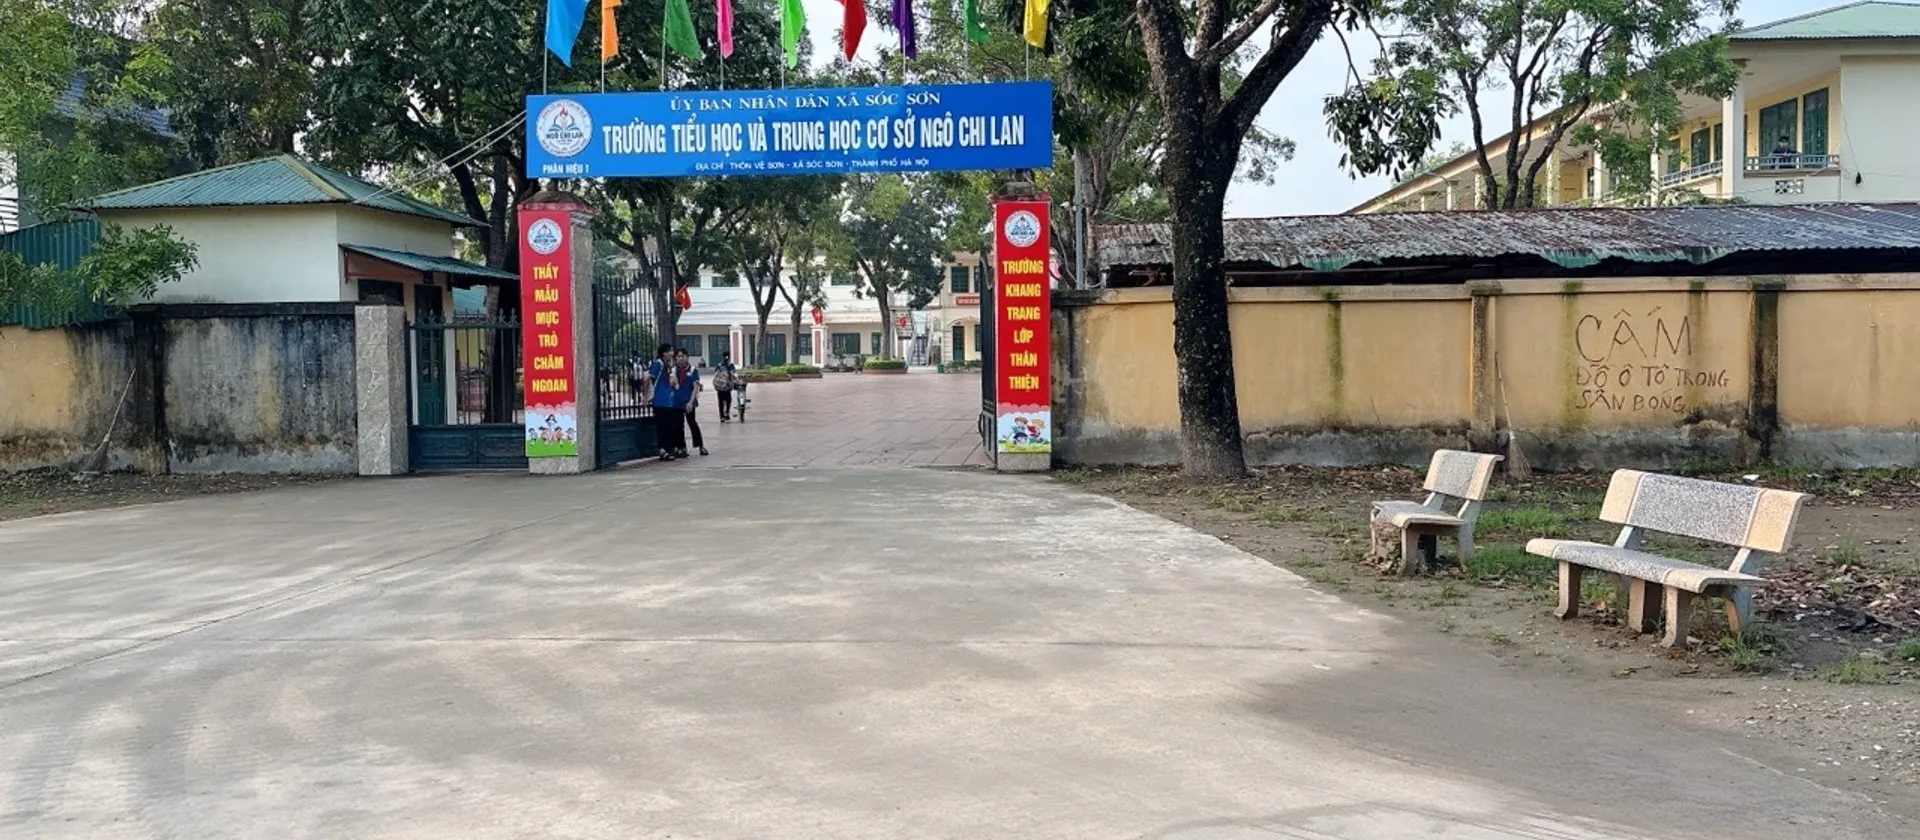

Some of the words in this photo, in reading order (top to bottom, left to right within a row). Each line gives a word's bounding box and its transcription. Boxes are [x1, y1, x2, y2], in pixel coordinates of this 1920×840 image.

[700, 99, 733, 110] BAN
[739, 94, 788, 110] NHÂN
[795, 92, 829, 108] DÂN
[836, 91, 859, 107] XÃ
[865, 90, 898, 106] SÓC
[906, 91, 940, 105] SƠN
[602, 117, 666, 154] TRƯỜNG
[671, 113, 705, 152] TIỂU
[711, 122, 743, 157] HỌC
[748, 116, 767, 152] VÀ
[772, 120, 825, 152] TRUNG
[829, 119, 861, 155] HỌC
[866, 116, 889, 150] CƠ
[893, 108, 916, 149] SỞ
[920, 111, 954, 148] NGÔ
[958, 116, 986, 147] CHI
[990, 114, 1025, 146] LAN
[542, 163, 564, 174] PHÂN
[565, 162, 583, 175] HIỆU
[585, 163, 590, 173] 1
[1002, 257, 1044, 274] TRƯỜNG
[1005, 283, 1041, 297] KHANG
[535, 310, 560, 328] MỰC
[1007, 306, 1041, 320] TRANG
[1013, 327, 1034, 344] LỚP
[1575, 306, 1692, 362] CẤM
[534, 354, 564, 370] CHĂM
[1008, 373, 1039, 392] THIỆN
[1618, 363, 1634, 387] Ô
[1673, 367, 1730, 388] TRONG
[532, 379, 568, 392] NGOAN
[1575, 388, 1626, 411] SÂN
